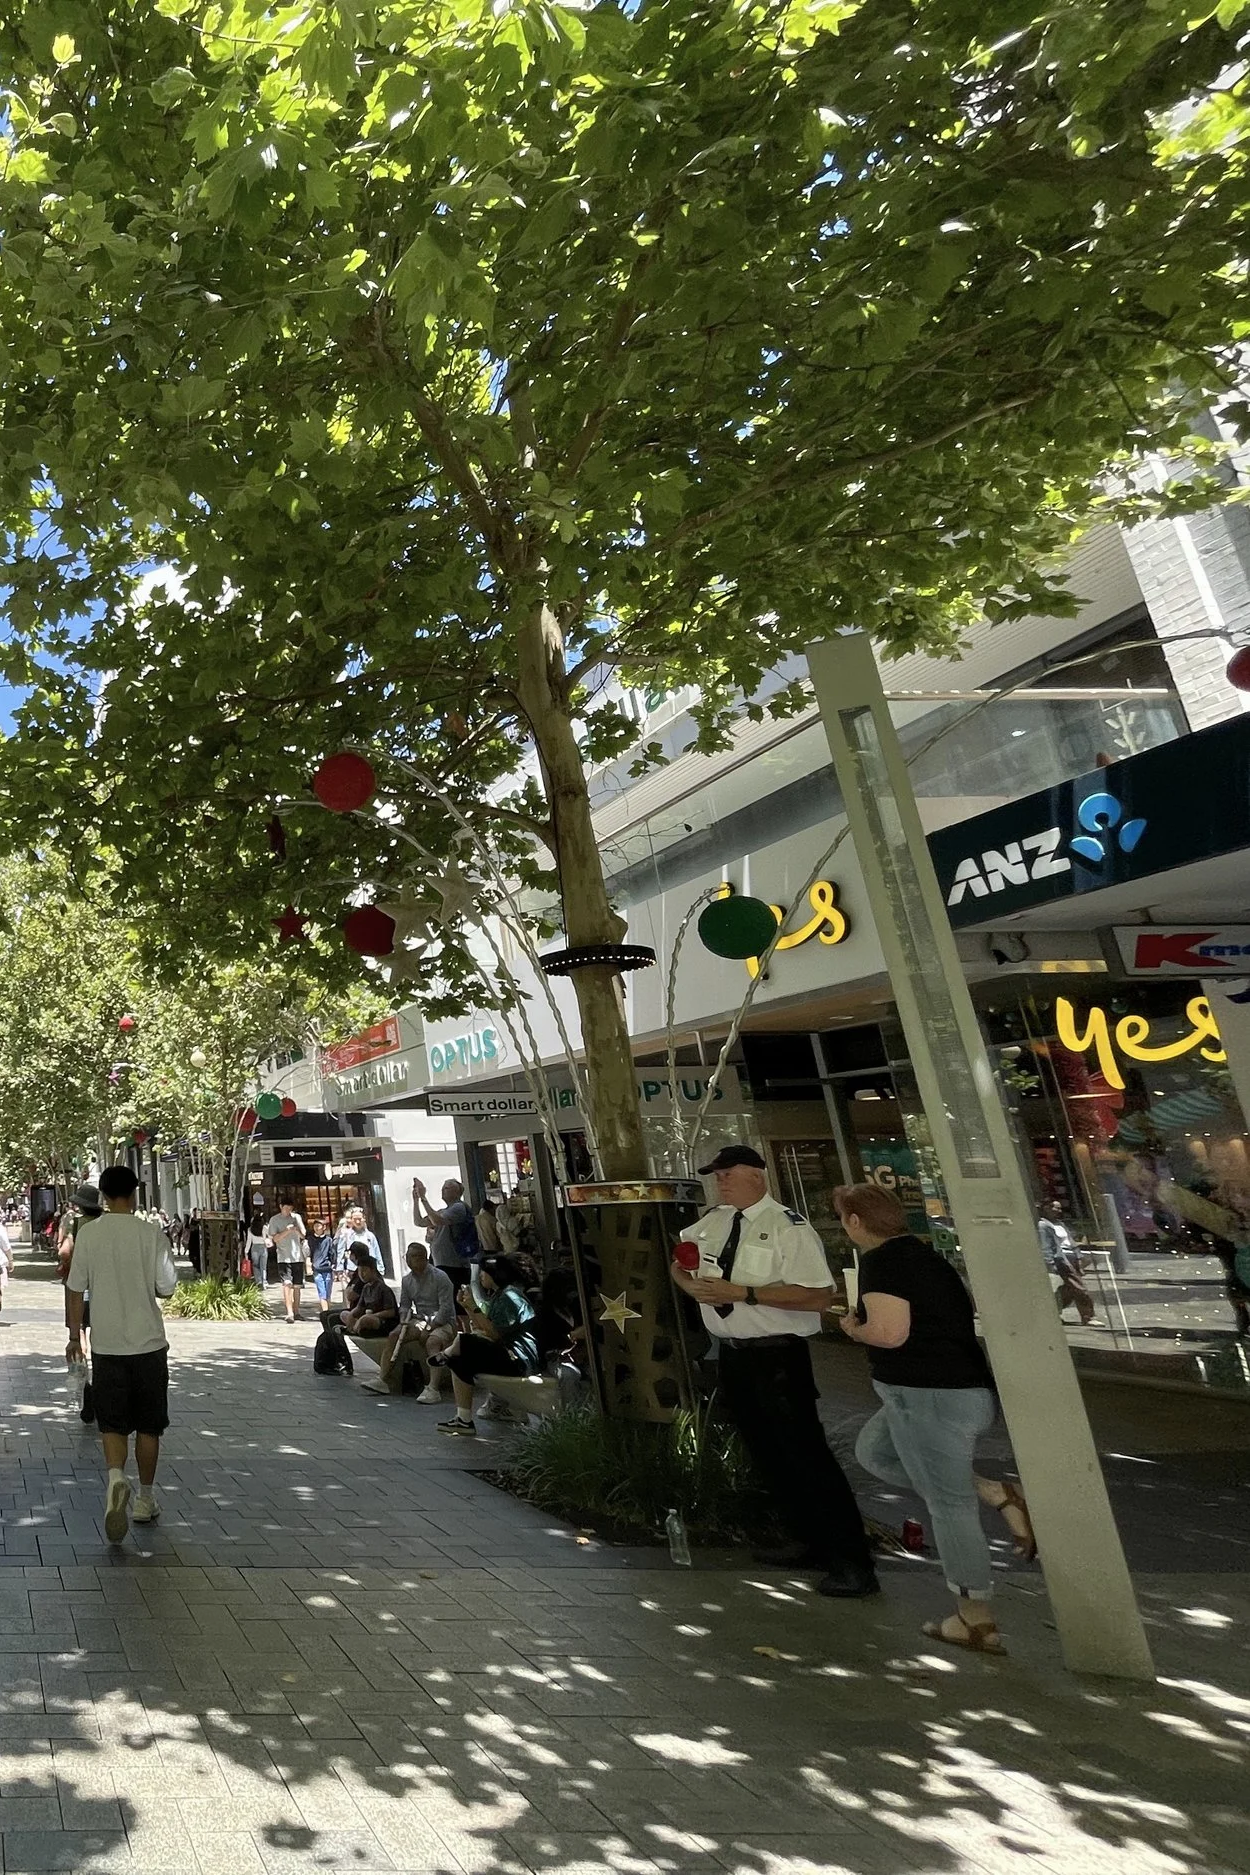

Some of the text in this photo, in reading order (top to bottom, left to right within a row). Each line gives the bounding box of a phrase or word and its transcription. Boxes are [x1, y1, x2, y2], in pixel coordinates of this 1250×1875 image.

[947, 827, 1071, 906] ANZ
[430, 1027, 498, 1073] OPTUS
[1056, 996, 1227, 1090] yes
[431, 1098, 534, 1112] Smart dollar
[638, 1079, 722, 1102] PTUS
